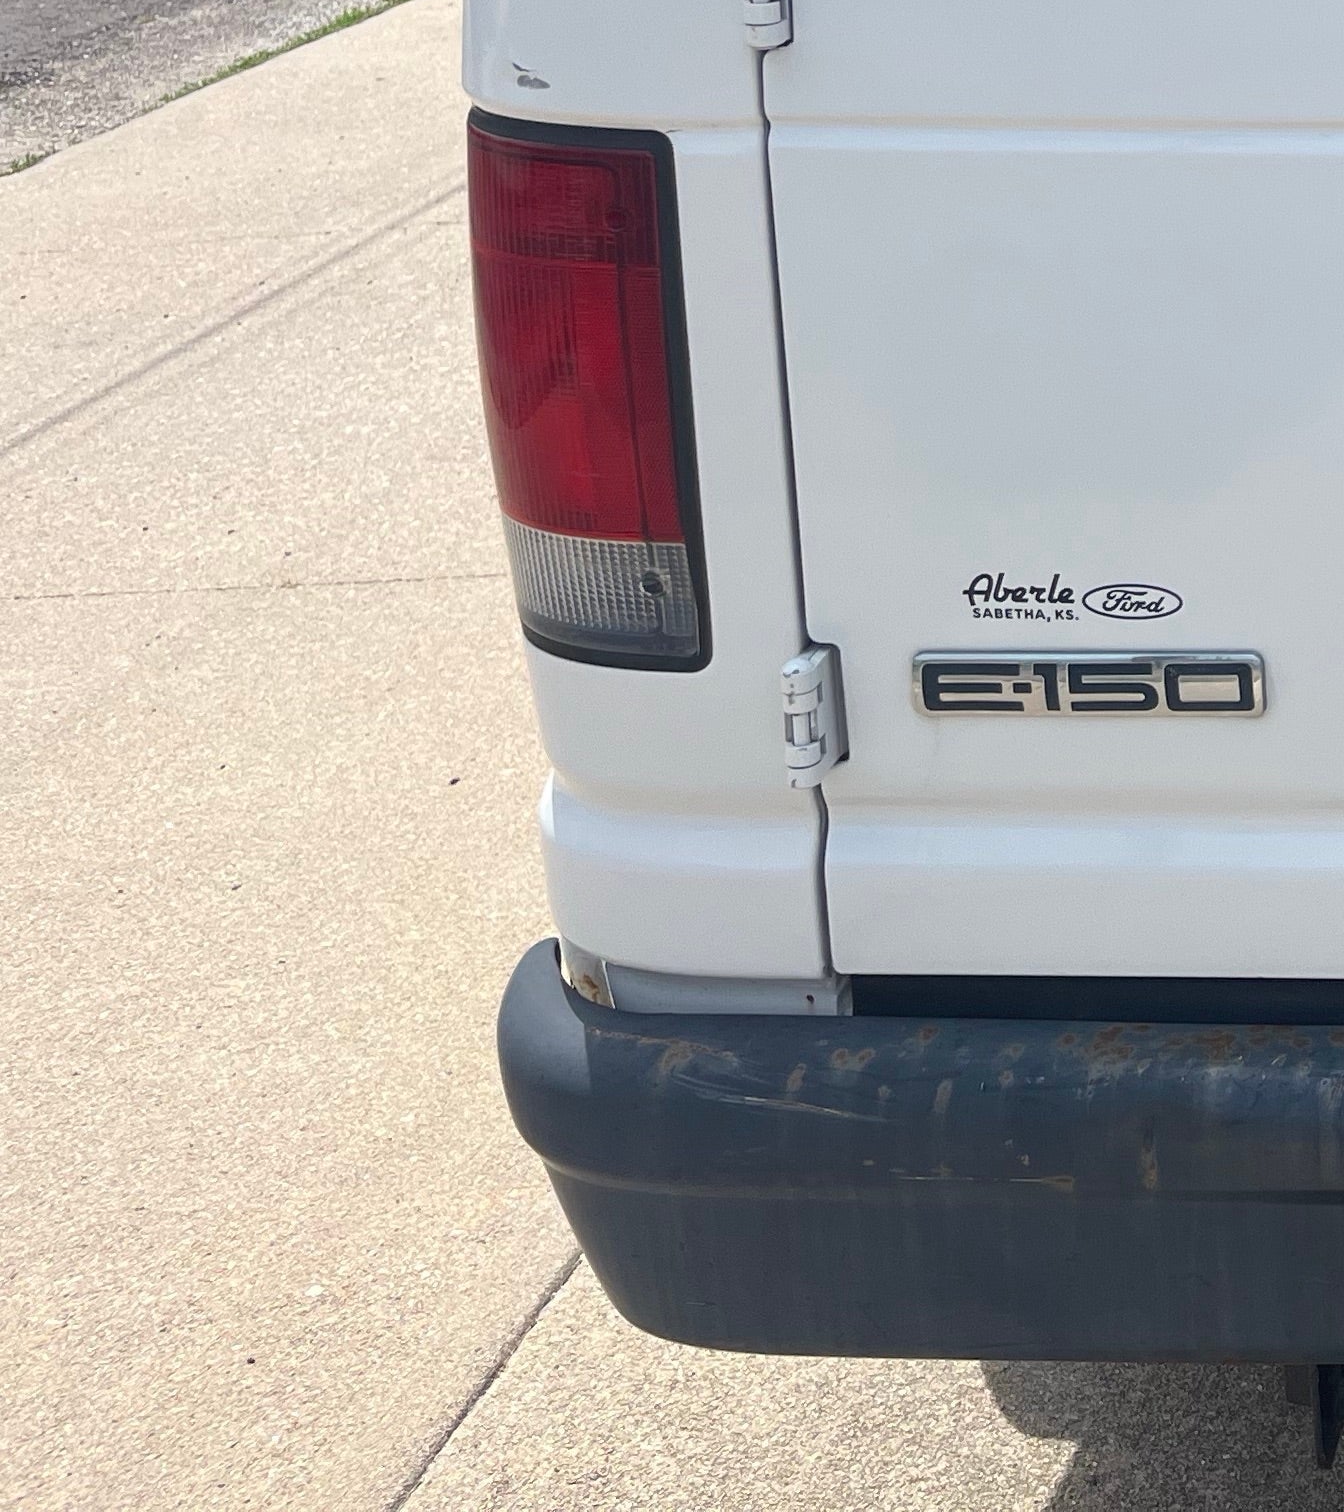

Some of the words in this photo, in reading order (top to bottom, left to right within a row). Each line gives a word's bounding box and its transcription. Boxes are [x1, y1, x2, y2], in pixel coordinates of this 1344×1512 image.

[962, 572, 1076, 606] Aberle
[1102, 589, 1166, 613] Ford
[972, 607, 1051, 623] SABETHA,
[1055, 609, 1080, 621] KS.
